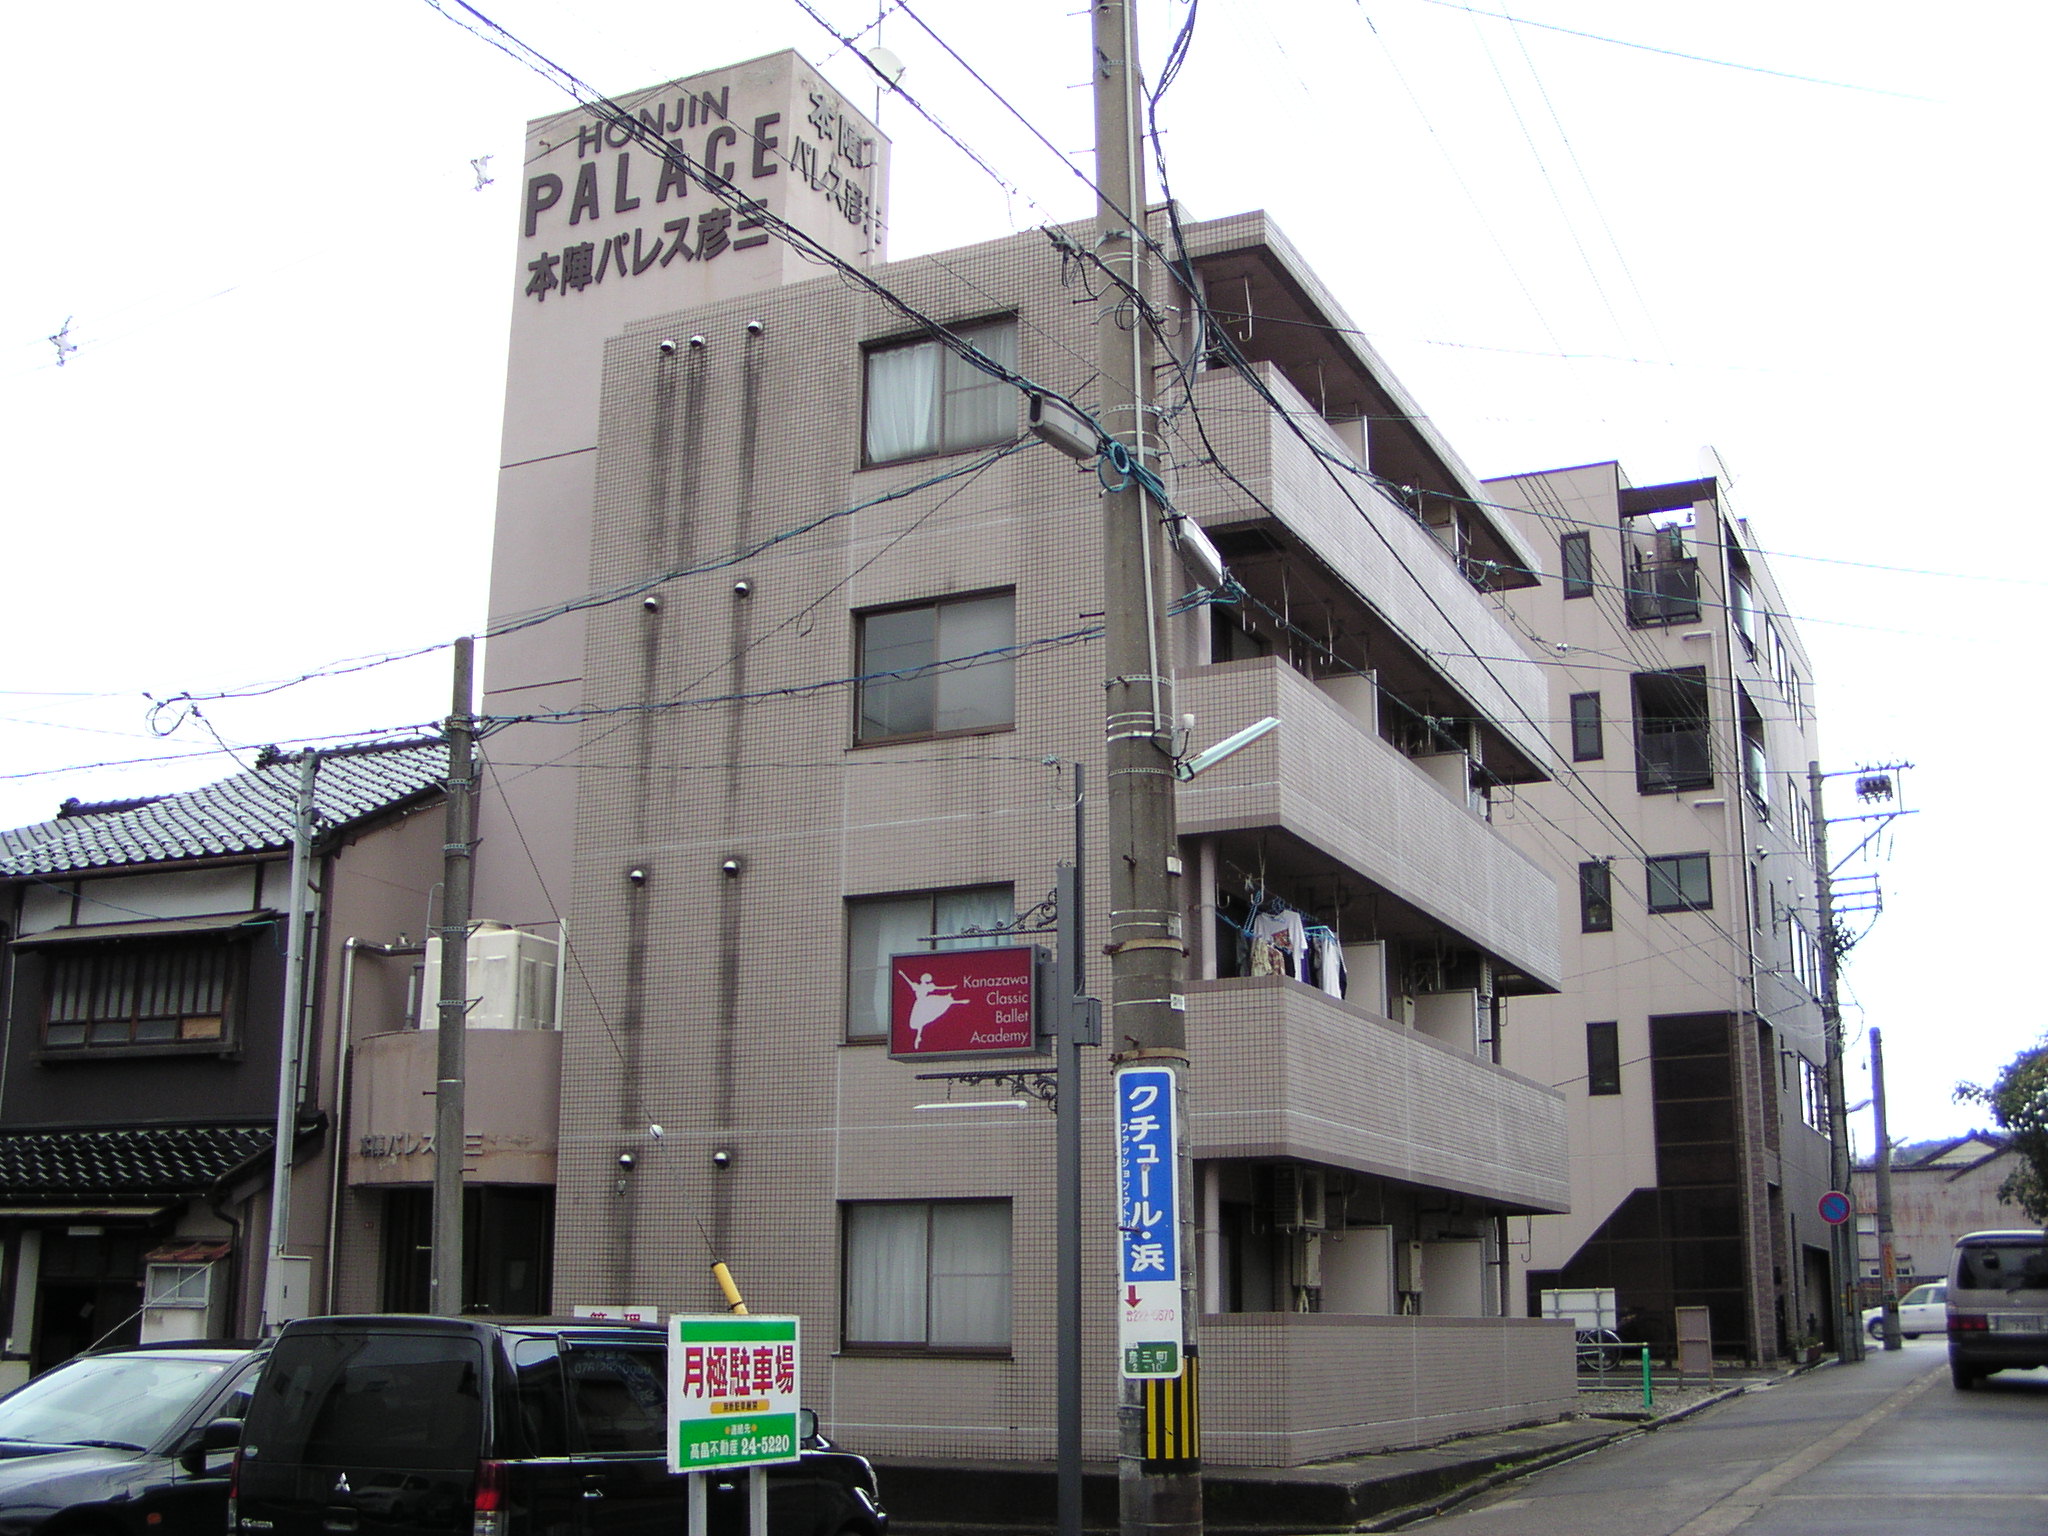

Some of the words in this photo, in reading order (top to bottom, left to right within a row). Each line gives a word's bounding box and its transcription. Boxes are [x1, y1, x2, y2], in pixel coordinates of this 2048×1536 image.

[577, 85, 730, 158] HONJIN
[524, 112, 781, 238] PALACE
[525, 198, 769, 302] 本陣パレス彦三
[963, 974, 1029, 989] Kanazawa
[986, 990, 1029, 1006] Classic
[995, 1009, 1029, 1024] Ballet
[969, 1027, 1029, 1045] Academy
[682, 1344, 795, 1399] 月極駐車場
[740, 1434, 791, 1456] 24-5220
